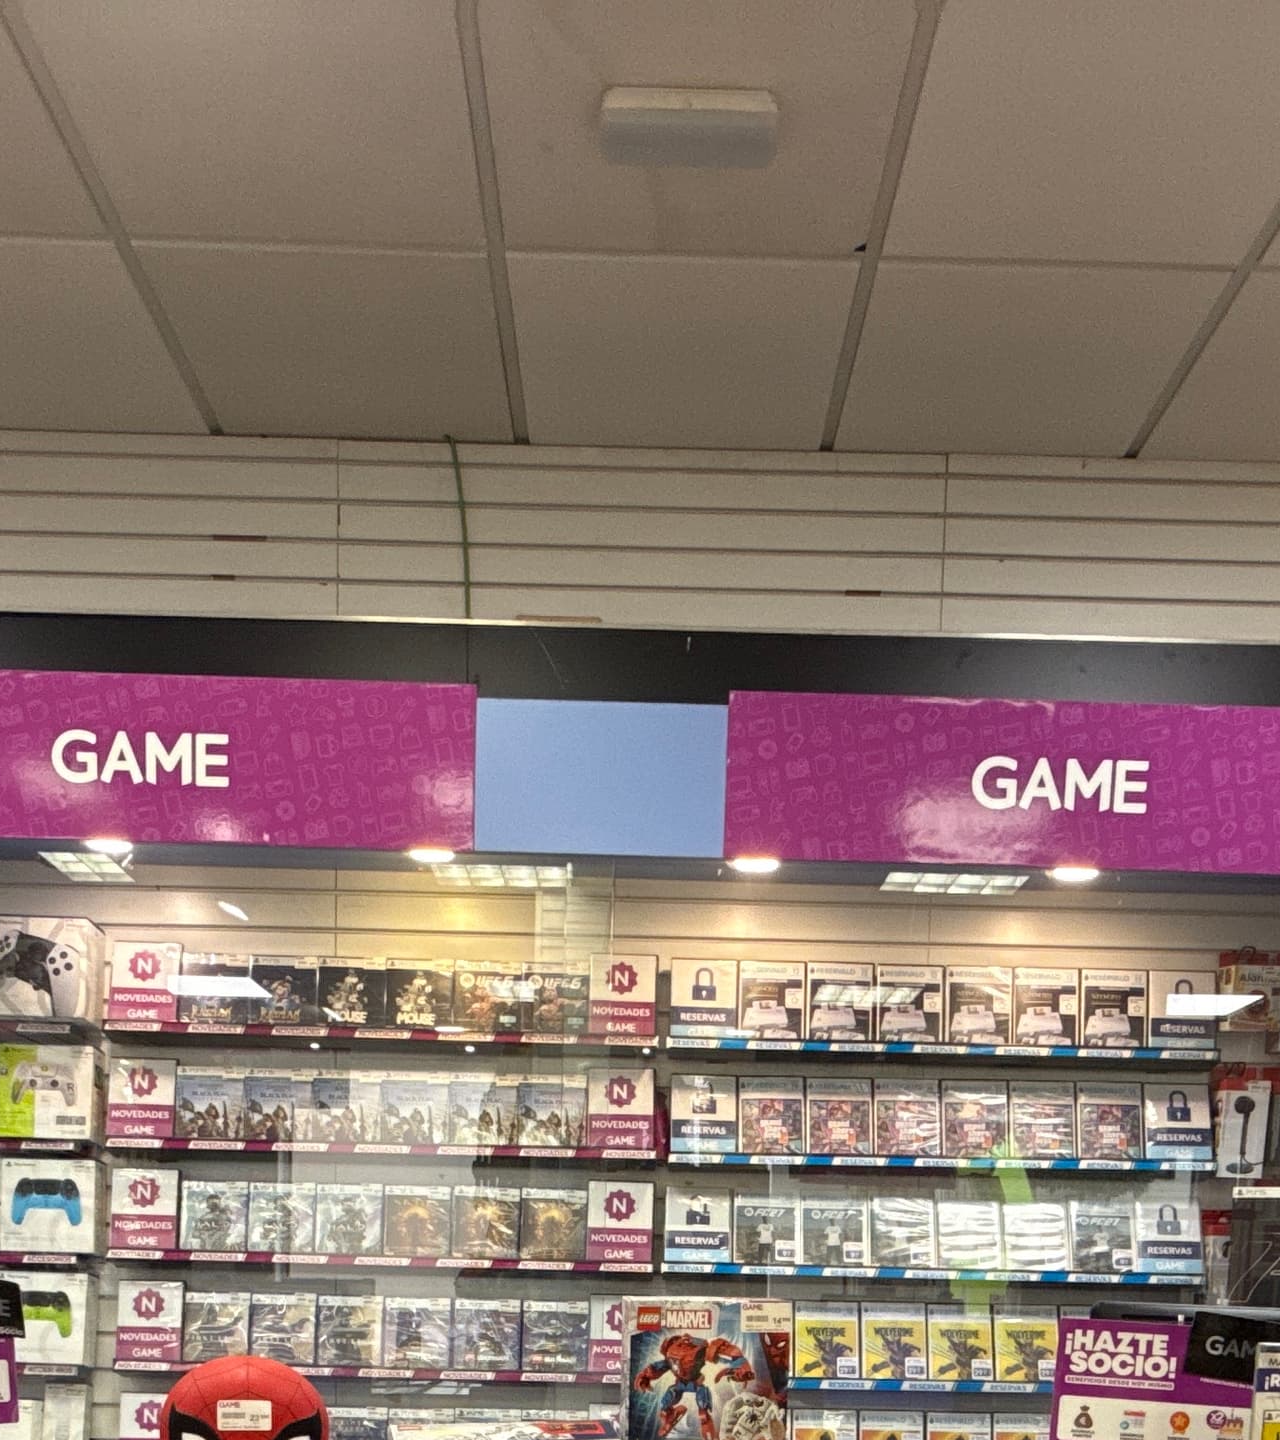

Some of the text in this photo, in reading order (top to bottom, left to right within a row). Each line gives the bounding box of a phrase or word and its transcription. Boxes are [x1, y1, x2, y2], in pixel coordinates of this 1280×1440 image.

[52, 730, 229, 787] GAME
[972, 756, 1149, 813] GAME
[681, 1013, 726, 1021] RESERVAS
[591, 1234, 647, 1243] NOVEDADES
[604, 1249, 634, 1259] GAME
[1148, 1246, 1192, 1255] RESERVAS
[639, 1311, 711, 1329] LEGO MARVEL
[119, 1332, 176, 1342] NOVEDADES
[1066, 1330, 1168, 1356] ¡HAZTE
[133, 1347, 162, 1357] GAME
[1069, 1353, 1176, 1379] SOCIO!
